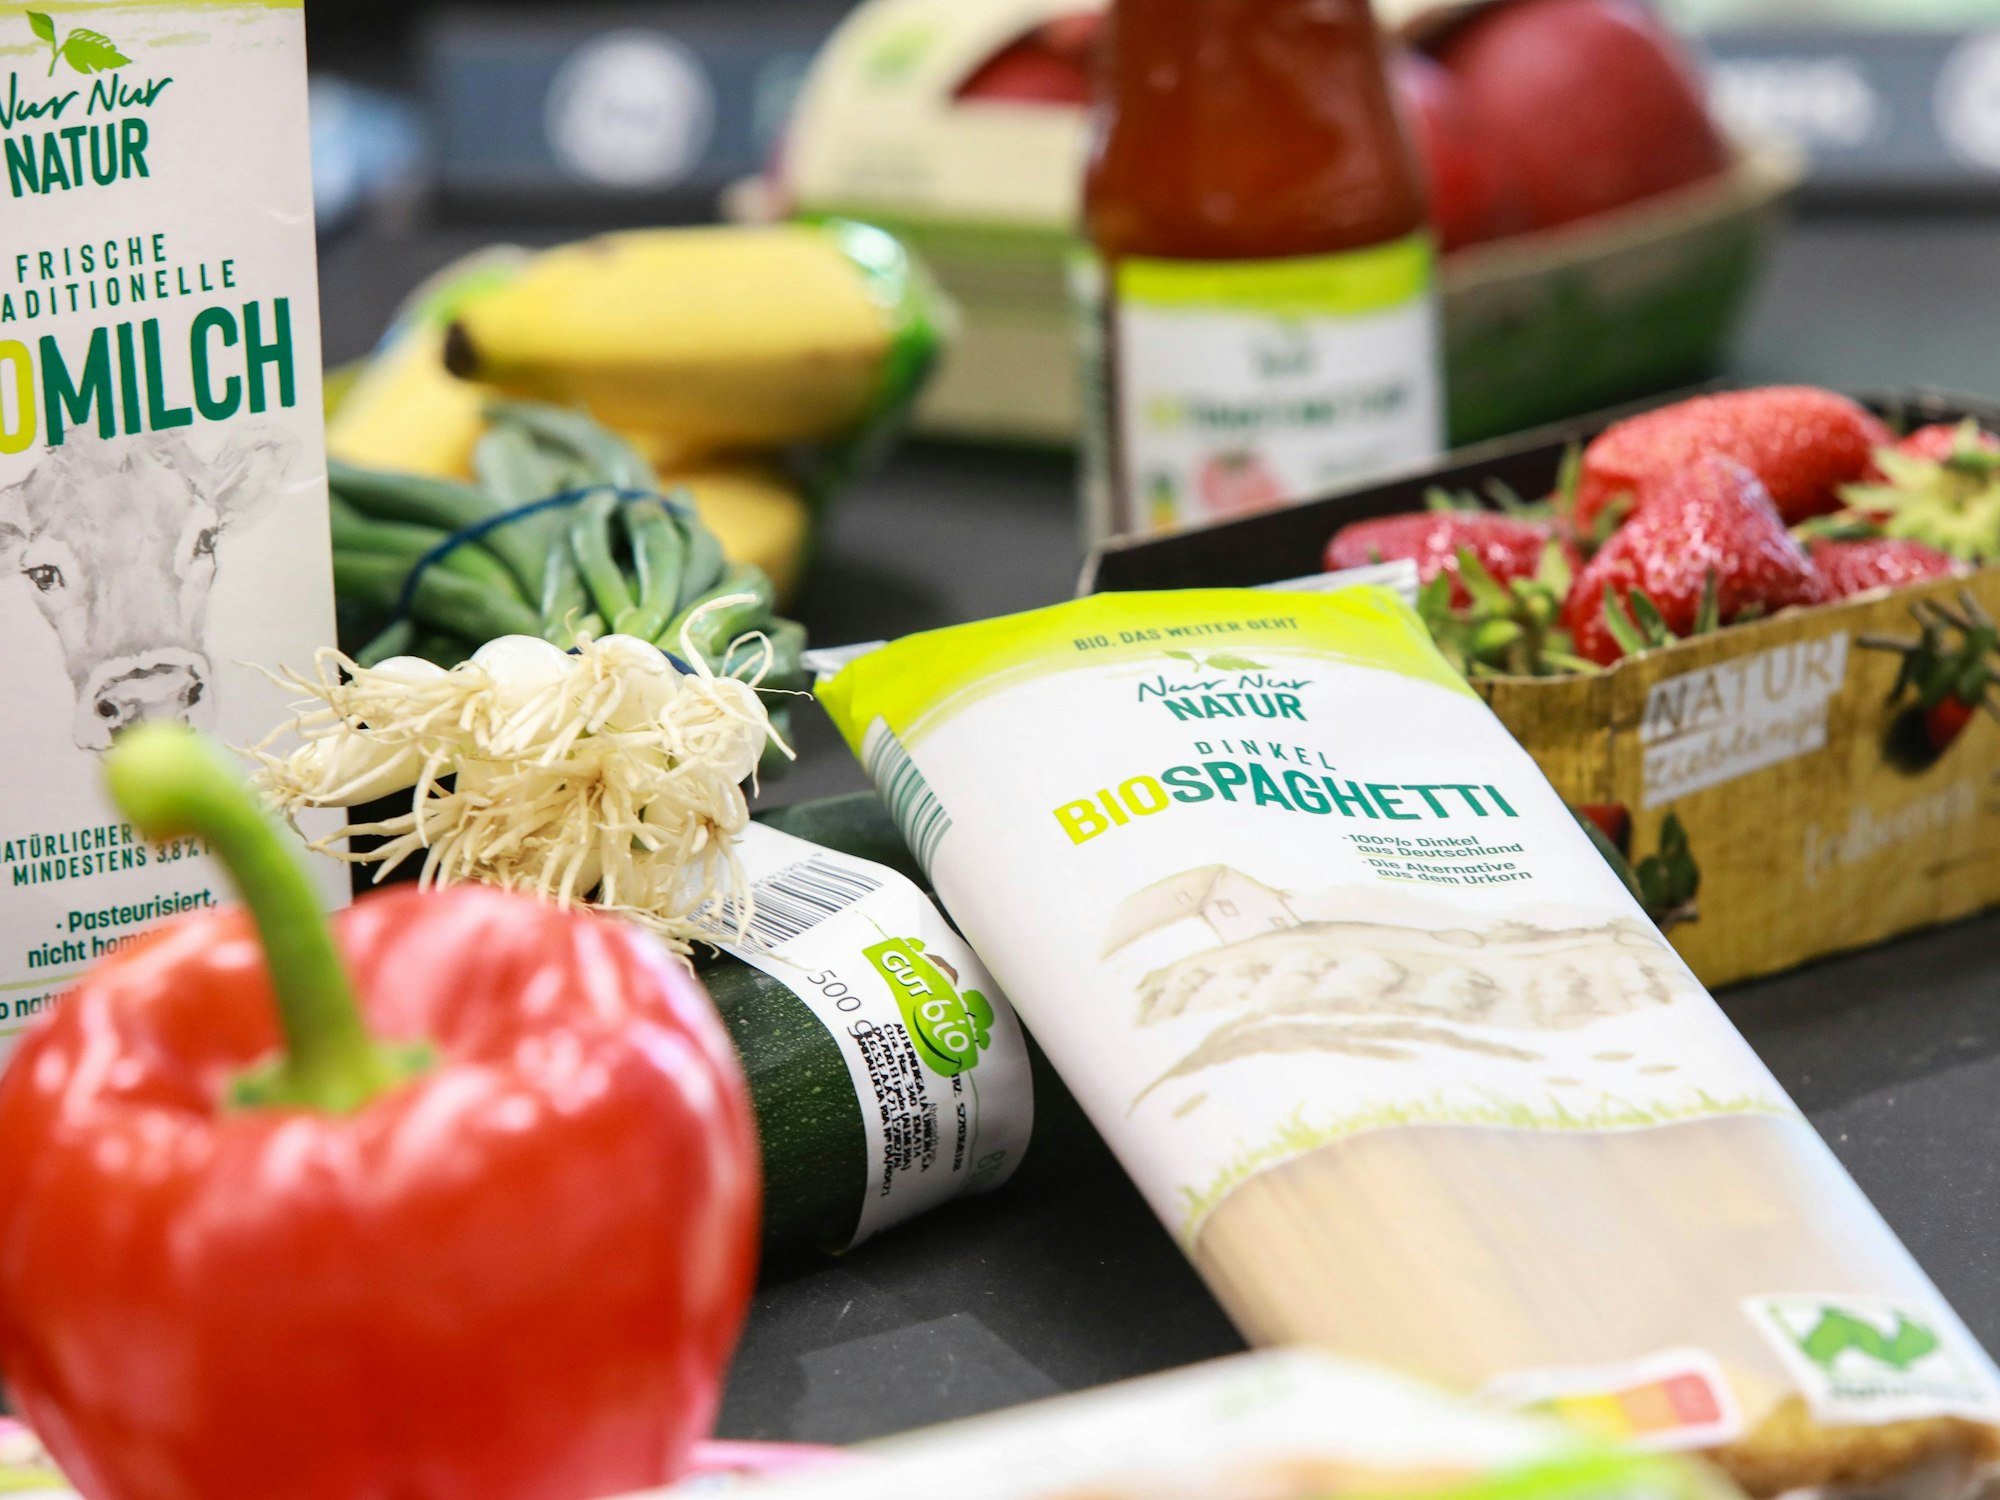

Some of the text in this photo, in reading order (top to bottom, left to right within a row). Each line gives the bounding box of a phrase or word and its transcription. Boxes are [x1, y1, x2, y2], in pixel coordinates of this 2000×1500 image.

[87, 73, 173, 116] Nur
[4, 118, 150, 198] NATUR
[16, 233, 167, 284] FRISCHE
[0, 259, 236, 323] ADITIONELLE
[0, 297, 296, 455] OMILCH
[1119, 628, 1161, 645] DAS
[1163, 621, 1242, 638] WEITER
[1246, 617, 1299, 632] GEHT
[1138, 674, 1315, 702] Nur Nur
[1651, 637, 1835, 730] NATUR
[1162, 692, 1309, 722] NATUR
[1194, 739, 1337, 771] DINKEL
[1053, 761, 1520, 846] BIOSPAGHETTI
[0, 823, 134, 865] ATÜRLICHER
[13, 845, 147, 887] MINDESTENS
[156, 836, 200, 864] 3,8%
[1357, 842, 1525, 858] aus Deutschland
[1415, 835, 1480, 848] Dinkel
[1368, 858, 1517, 876] Die Alternative
[1376, 868, 1534, 885] aus dem Urkorn
[67, 887, 218, 933] Pasteurisiert,
[28, 938, 87, 969] nicht
[807, 969, 874, 1040] 500 g
[881, 950, 970, 1053] GUT bio
